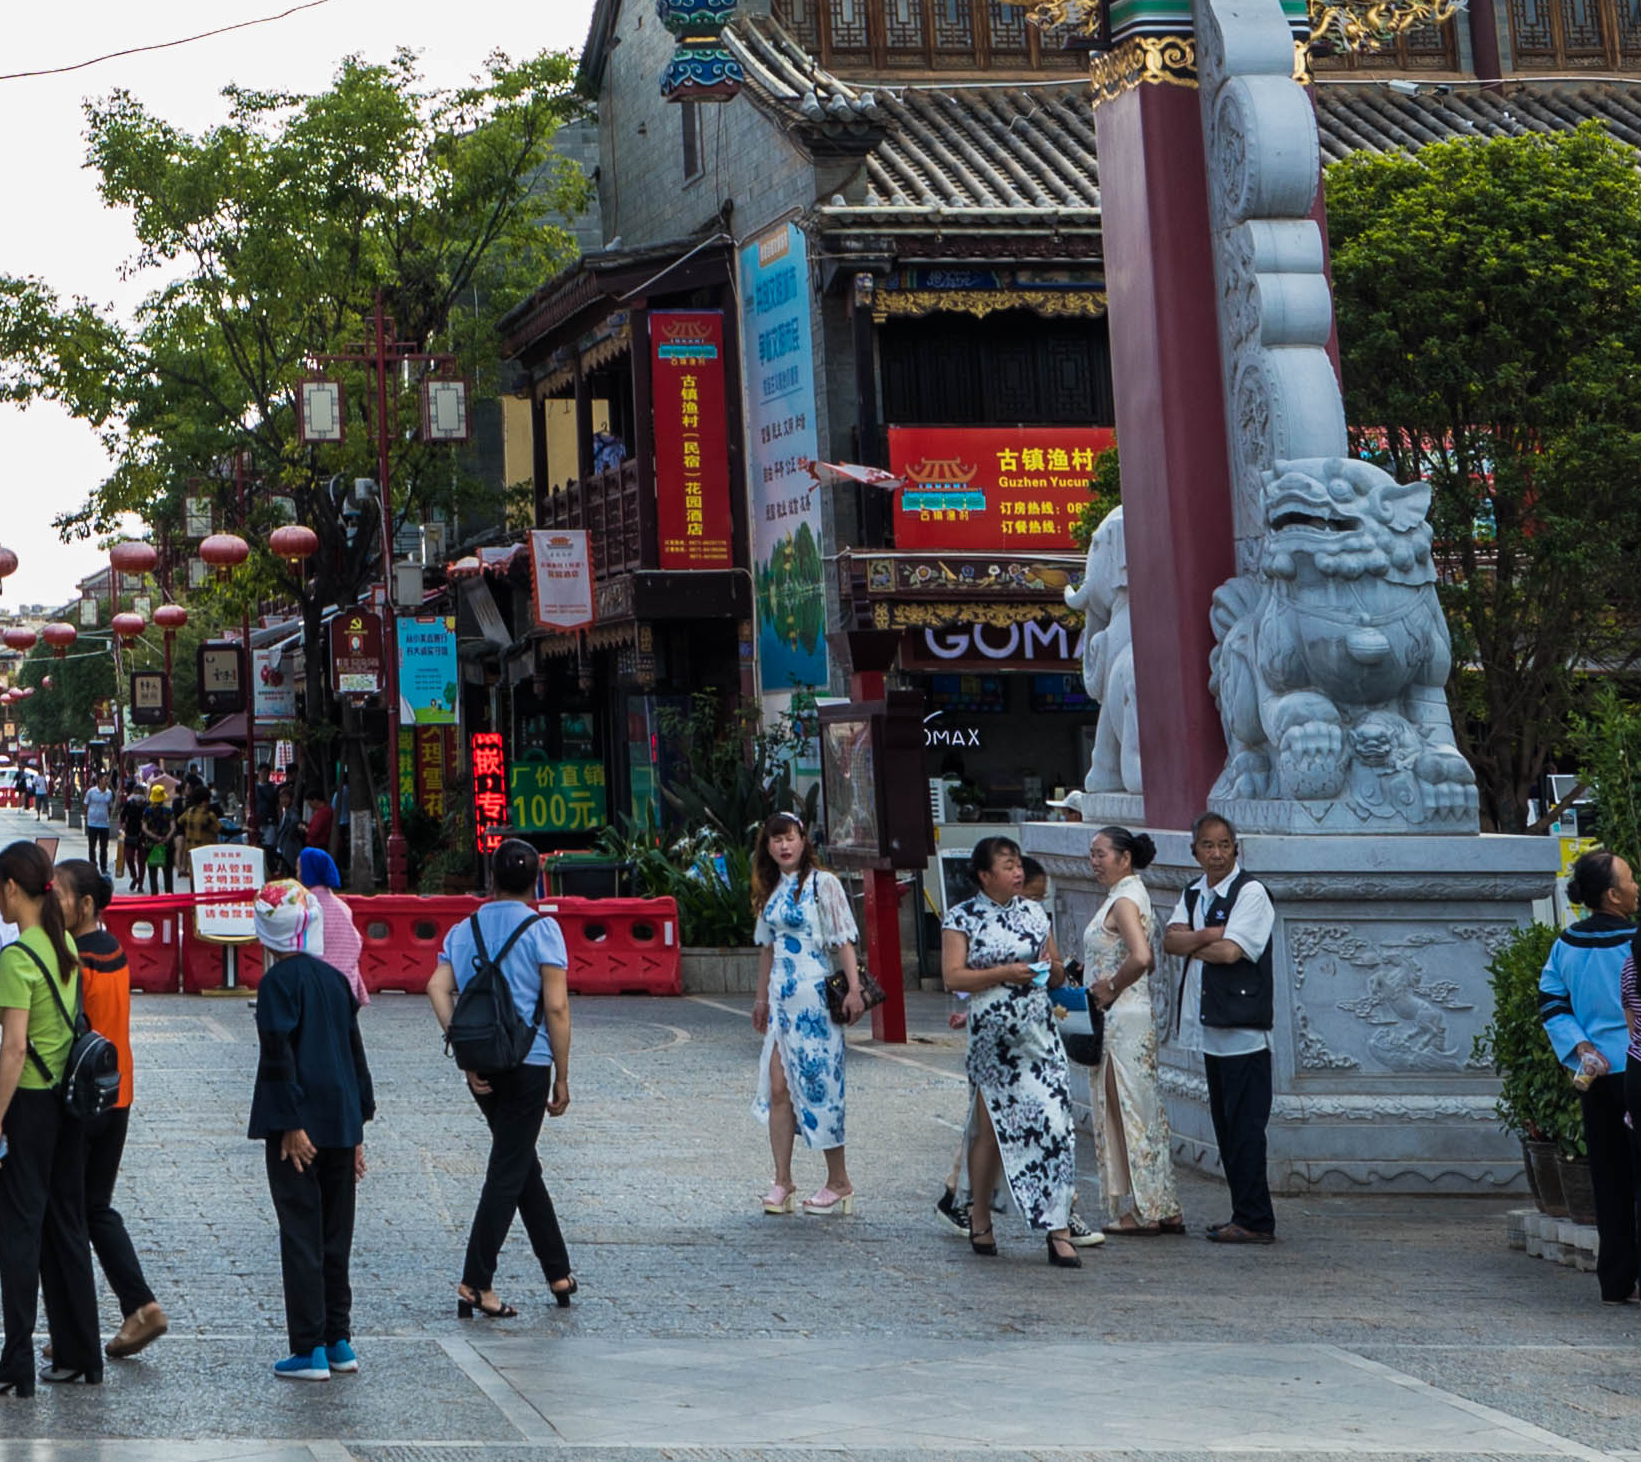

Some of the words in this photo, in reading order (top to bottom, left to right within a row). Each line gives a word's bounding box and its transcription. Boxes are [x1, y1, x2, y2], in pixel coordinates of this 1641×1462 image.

[996, 447, 1093, 472] 古镇渔村
[998, 476, 1048, 488] Guzhen
[511, 764, 606, 788] 厂价直销
